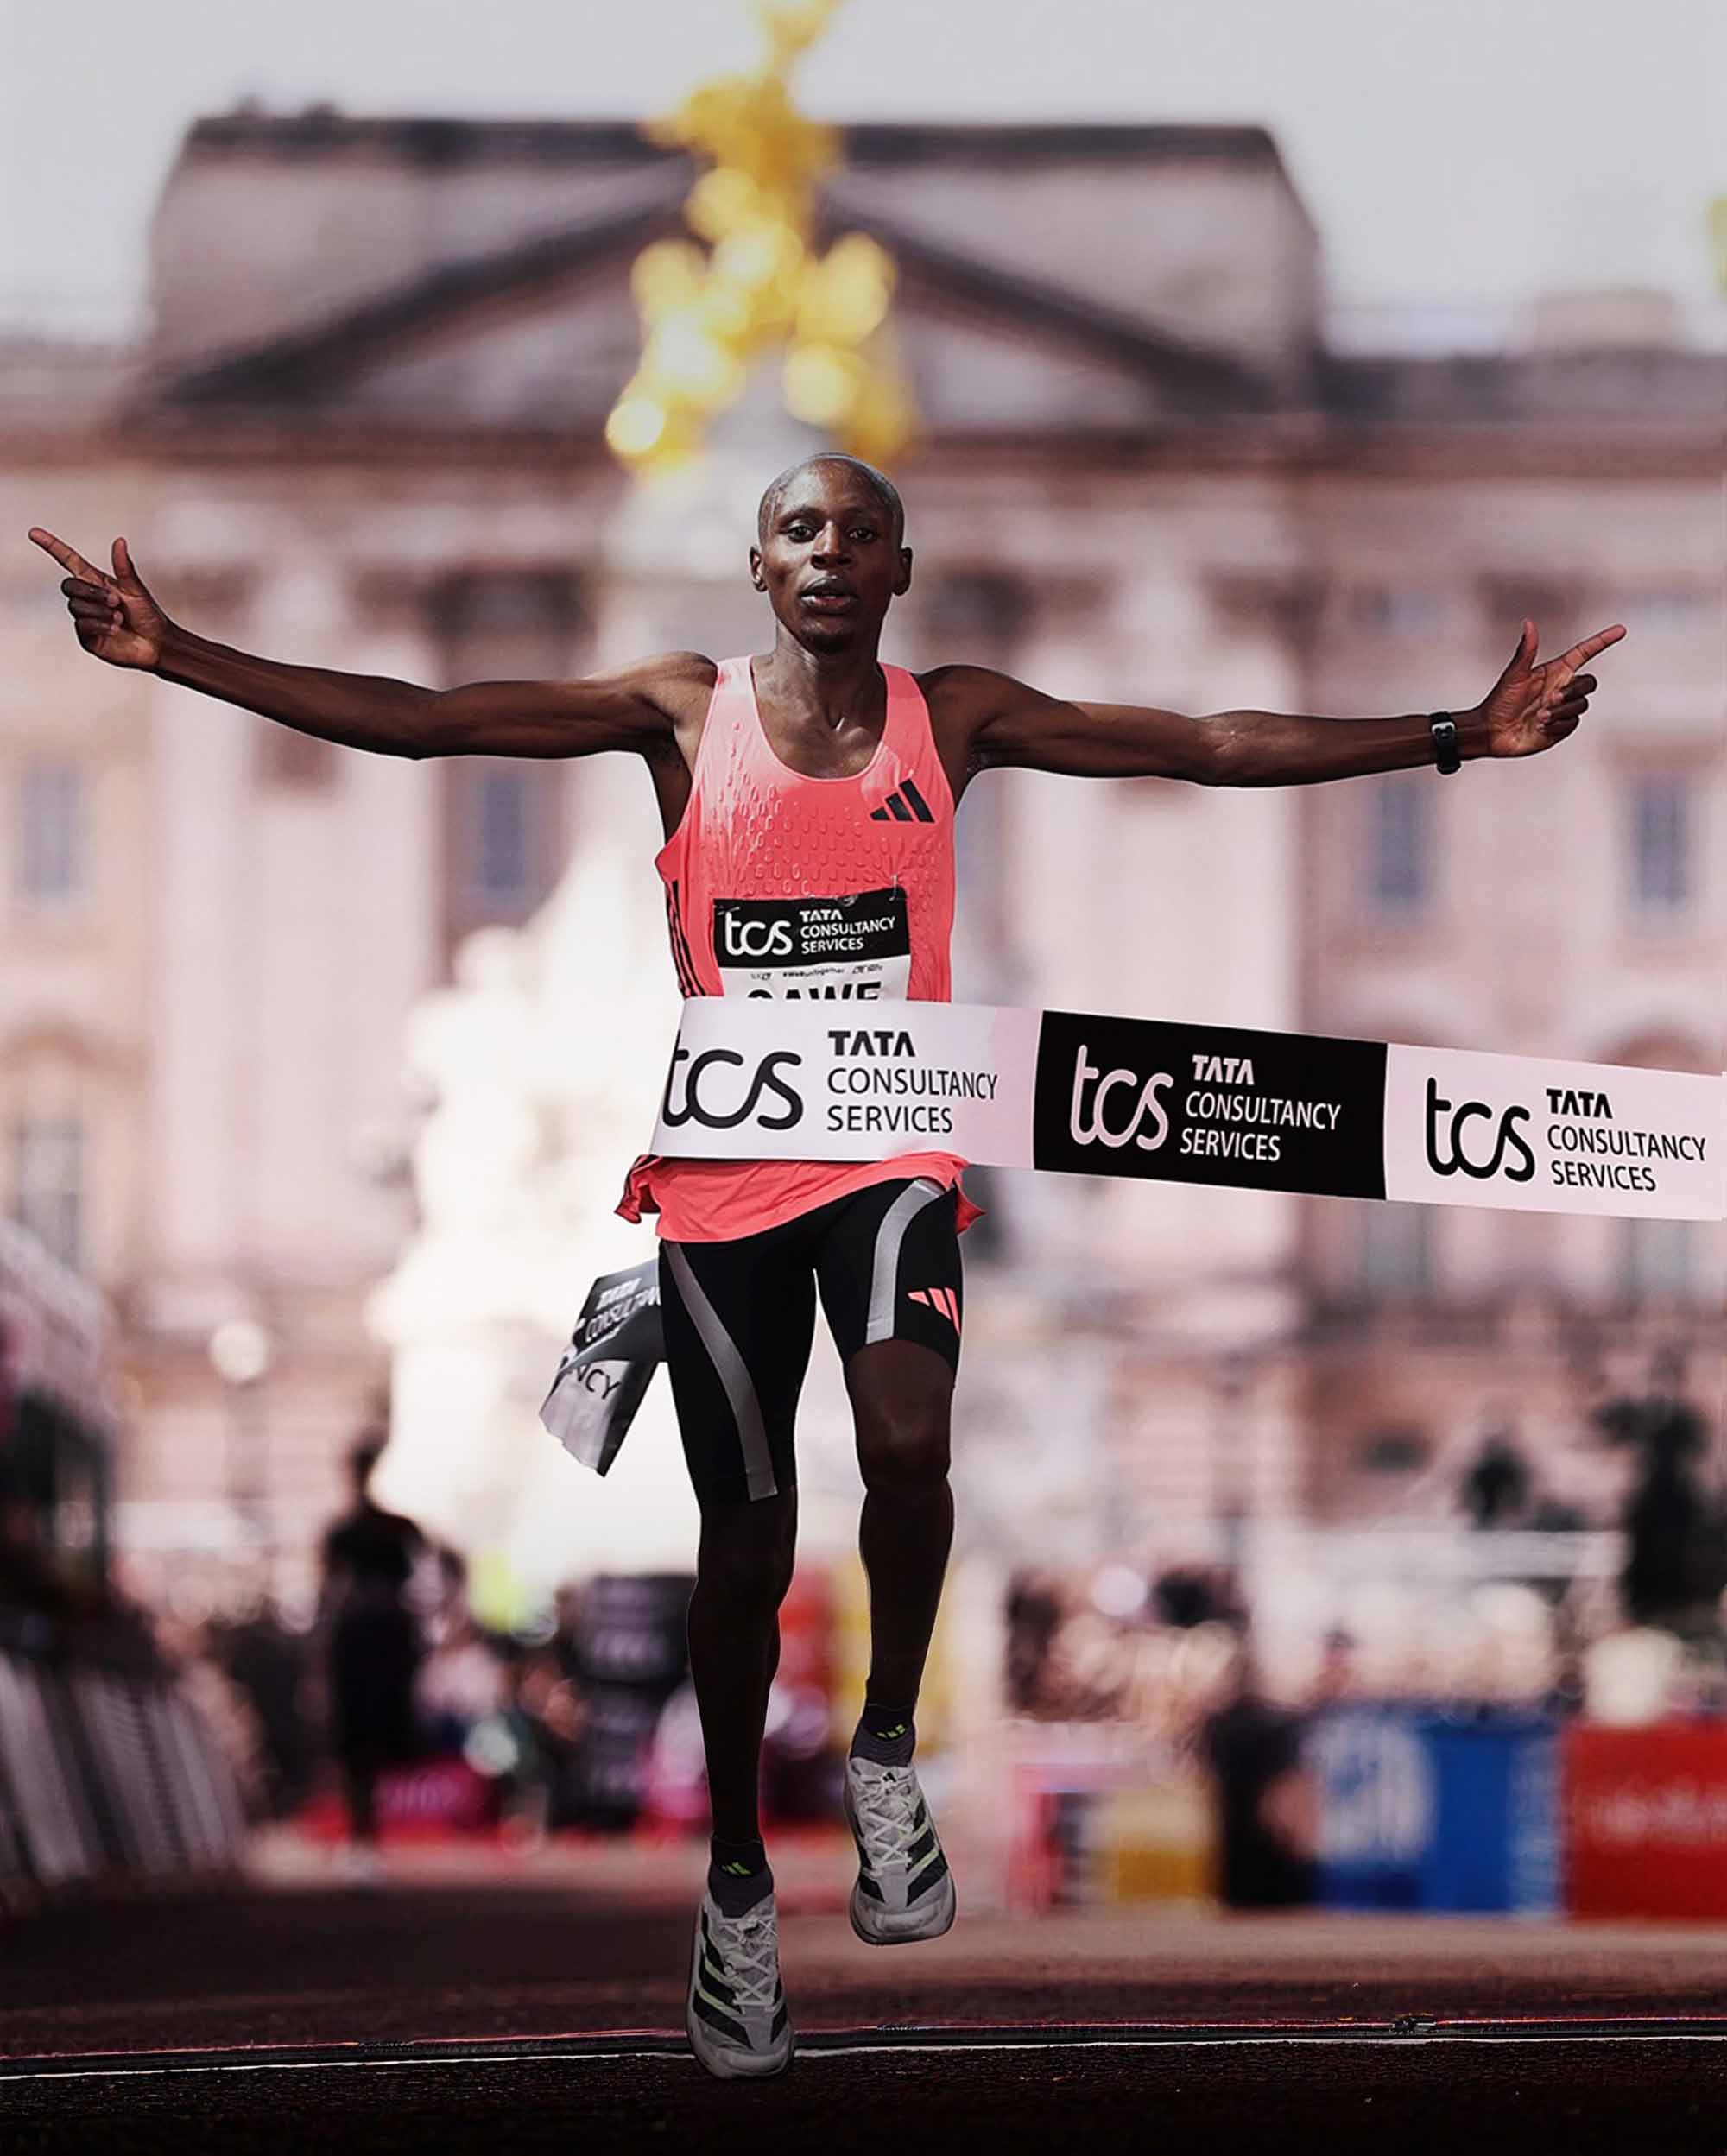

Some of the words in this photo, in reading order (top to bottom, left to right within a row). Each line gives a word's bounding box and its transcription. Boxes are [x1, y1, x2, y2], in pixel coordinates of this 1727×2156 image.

[800, 909, 843, 923] TATA
[800, 916, 896, 939] CONSULTANCY
[725, 911, 794, 956] tcs
[801, 937, 864, 955] SERVICES
[828, 1030, 916, 1058] TATA
[662, 1029, 804, 1130] tcs
[827, 1068, 999, 1100] CONSULTANCY
[1192, 1054, 1255, 1086] TATA
[1070, 1044, 1174, 1152] tcs
[1185, 1091, 1342, 1130] CONSULTANCY
[1546, 1088, 1613, 1120] TATA
[827, 1105, 953, 1133] SERVICES
[1427, 1077, 1536, 1183] tcs
[1180, 1128, 1281, 1162] SERVICES
[1547, 1125, 1706, 1161] CONSULTANCY
[1552, 1160, 1657, 1192] SERVICES
